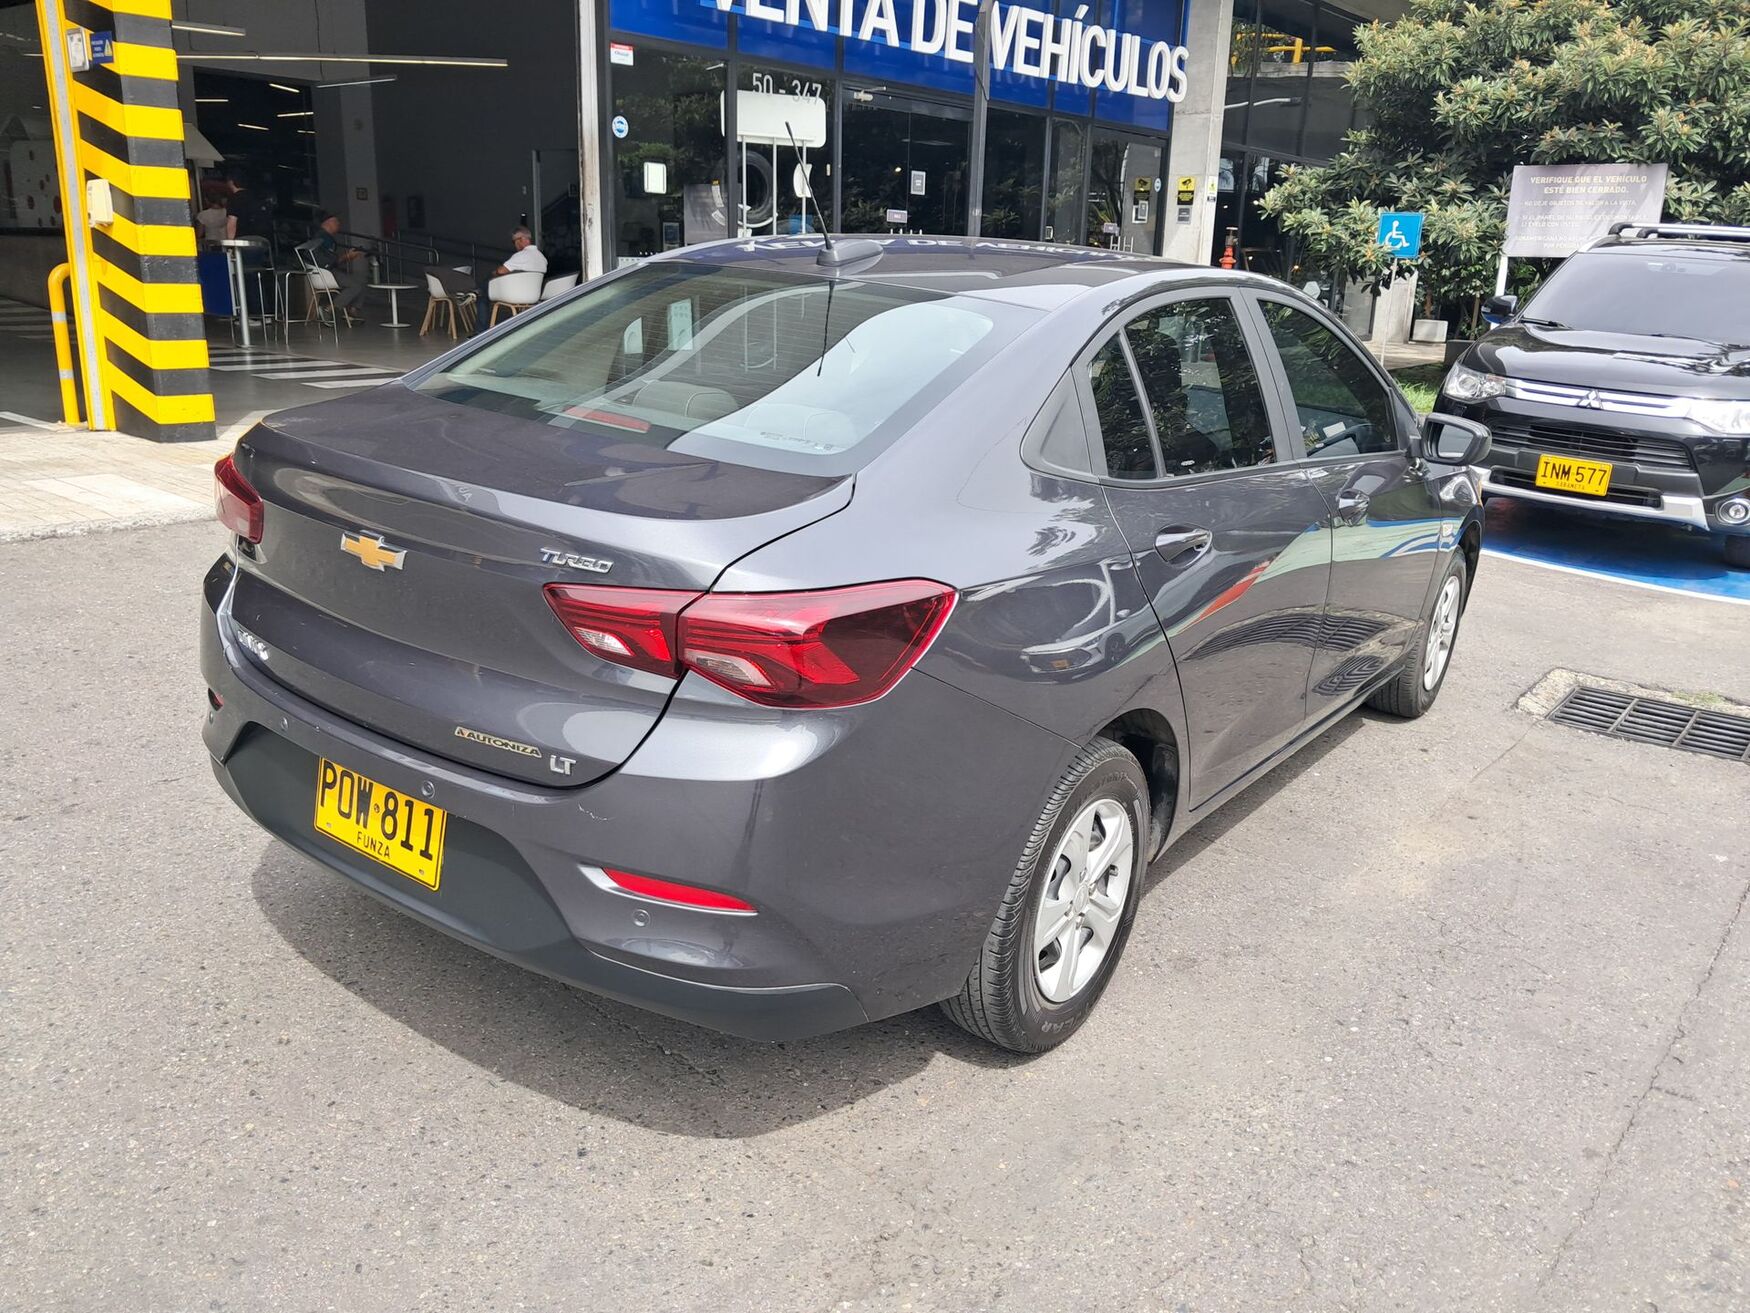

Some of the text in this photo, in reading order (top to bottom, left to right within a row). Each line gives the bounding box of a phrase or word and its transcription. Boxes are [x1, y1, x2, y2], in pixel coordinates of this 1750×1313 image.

[911, 0, 978, 63] DE
[990, 1, 1190, 103] VEHÍCULOS
[752, 72, 773, 95] 50
[791, 79, 822, 105] 347
[1530, 176, 1573, 184] VERIFIQUE
[1575, 176, 1591, 184] QUE
[1593, 175, 1604, 183] EL
[1566, 186, 1586, 194] BIEN
[1541, 461, 1607, 486] INM 577
[540, 547, 614, 574] TURBO
[466, 731, 541, 757] AUTONIZA
[550, 754, 577, 775] LT
[320, 760, 434, 861] POW 811
[356, 831, 391, 859] FUNZA
